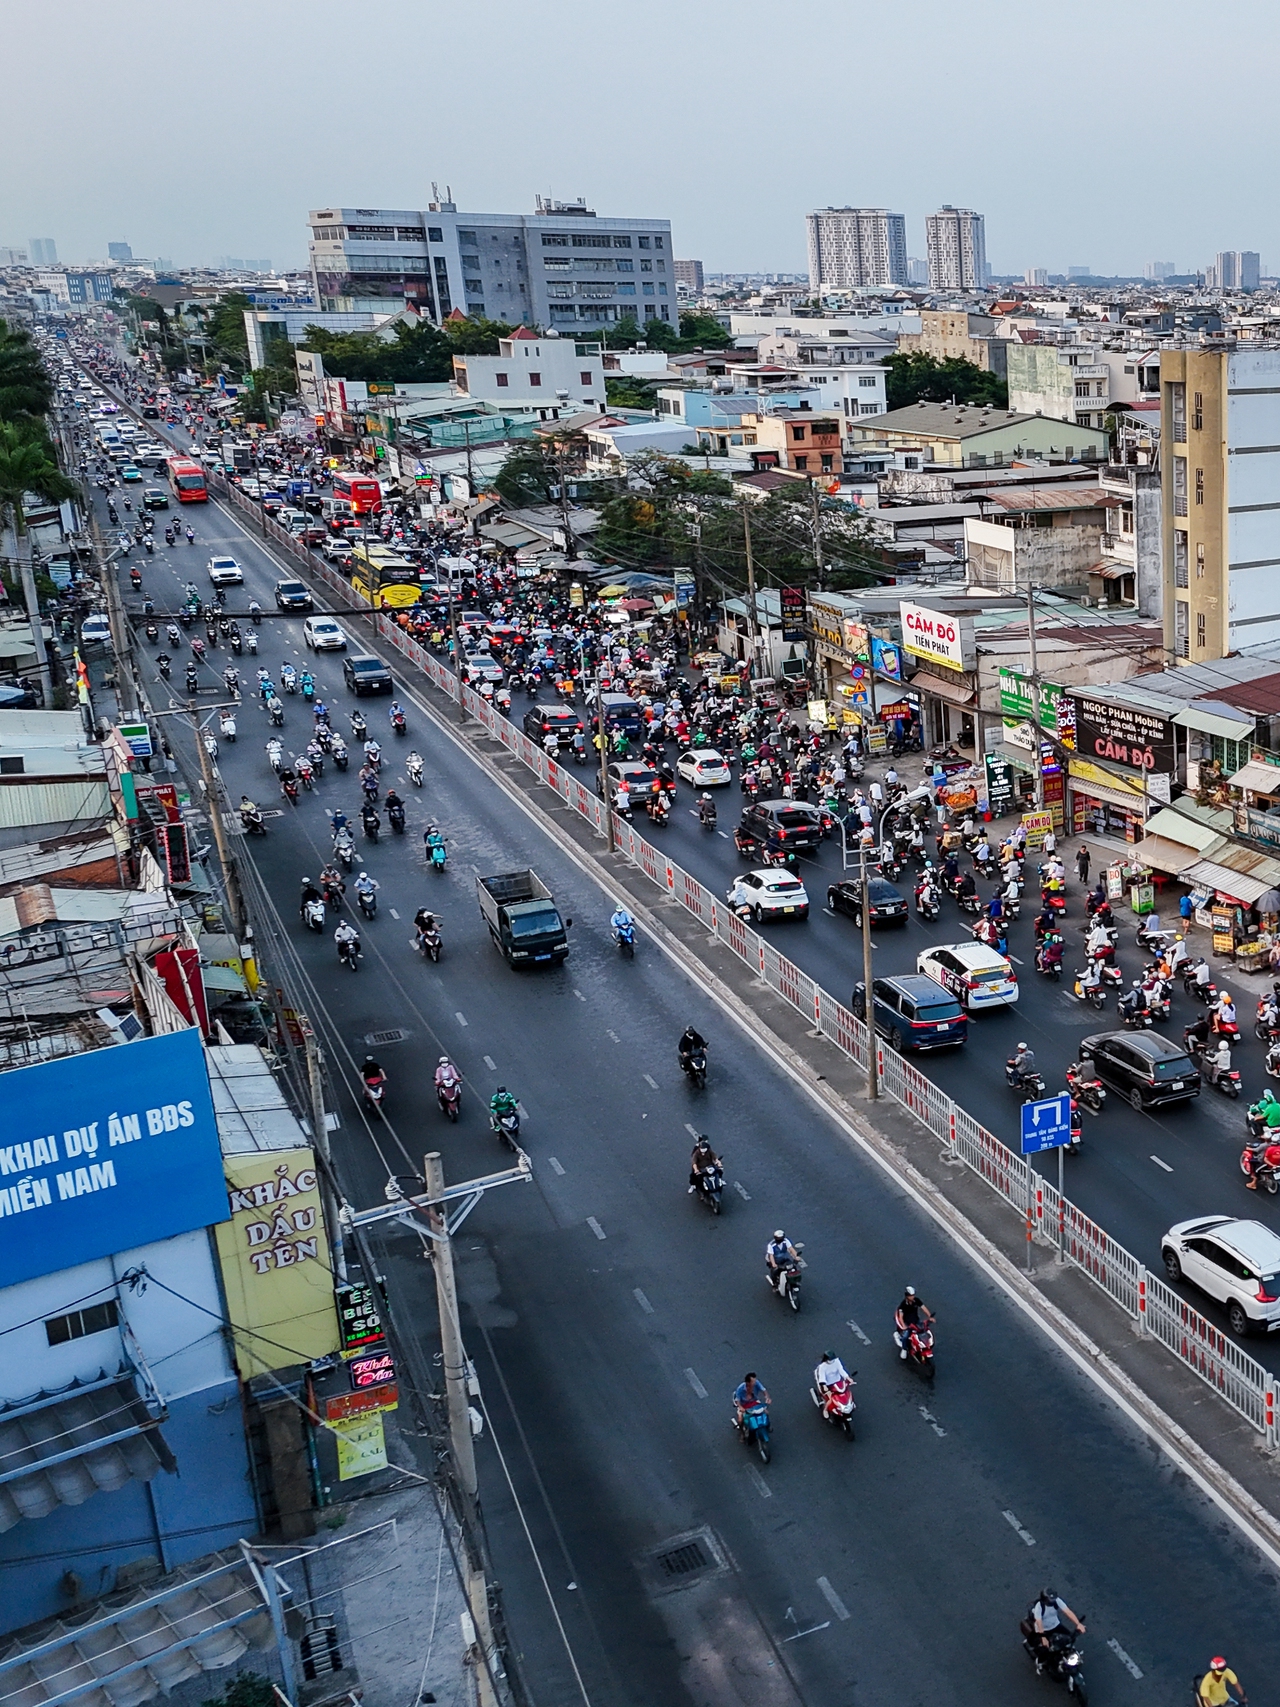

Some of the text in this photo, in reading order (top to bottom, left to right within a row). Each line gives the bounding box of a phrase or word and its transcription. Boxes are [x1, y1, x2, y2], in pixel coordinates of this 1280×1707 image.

[906, 611, 956, 642] CẦM ĐỒ
[1000, 675, 1018, 696] NHÀ
[1083, 700, 1108, 716] NGỌC
[1135, 713, 1164, 730] Mobile
[1094, 735, 1128, 762] CẦM
[1131, 745, 1155, 769] ĐỒ
[1, 1100, 196, 1176] KHAI DỰ ÁN BĐS
[56, 1160, 118, 1200] NAM
[230, 1164, 317, 1214] KHẮC
[246, 1202, 317, 1248] DẤU
[251, 1237, 318, 1275] TÊN
